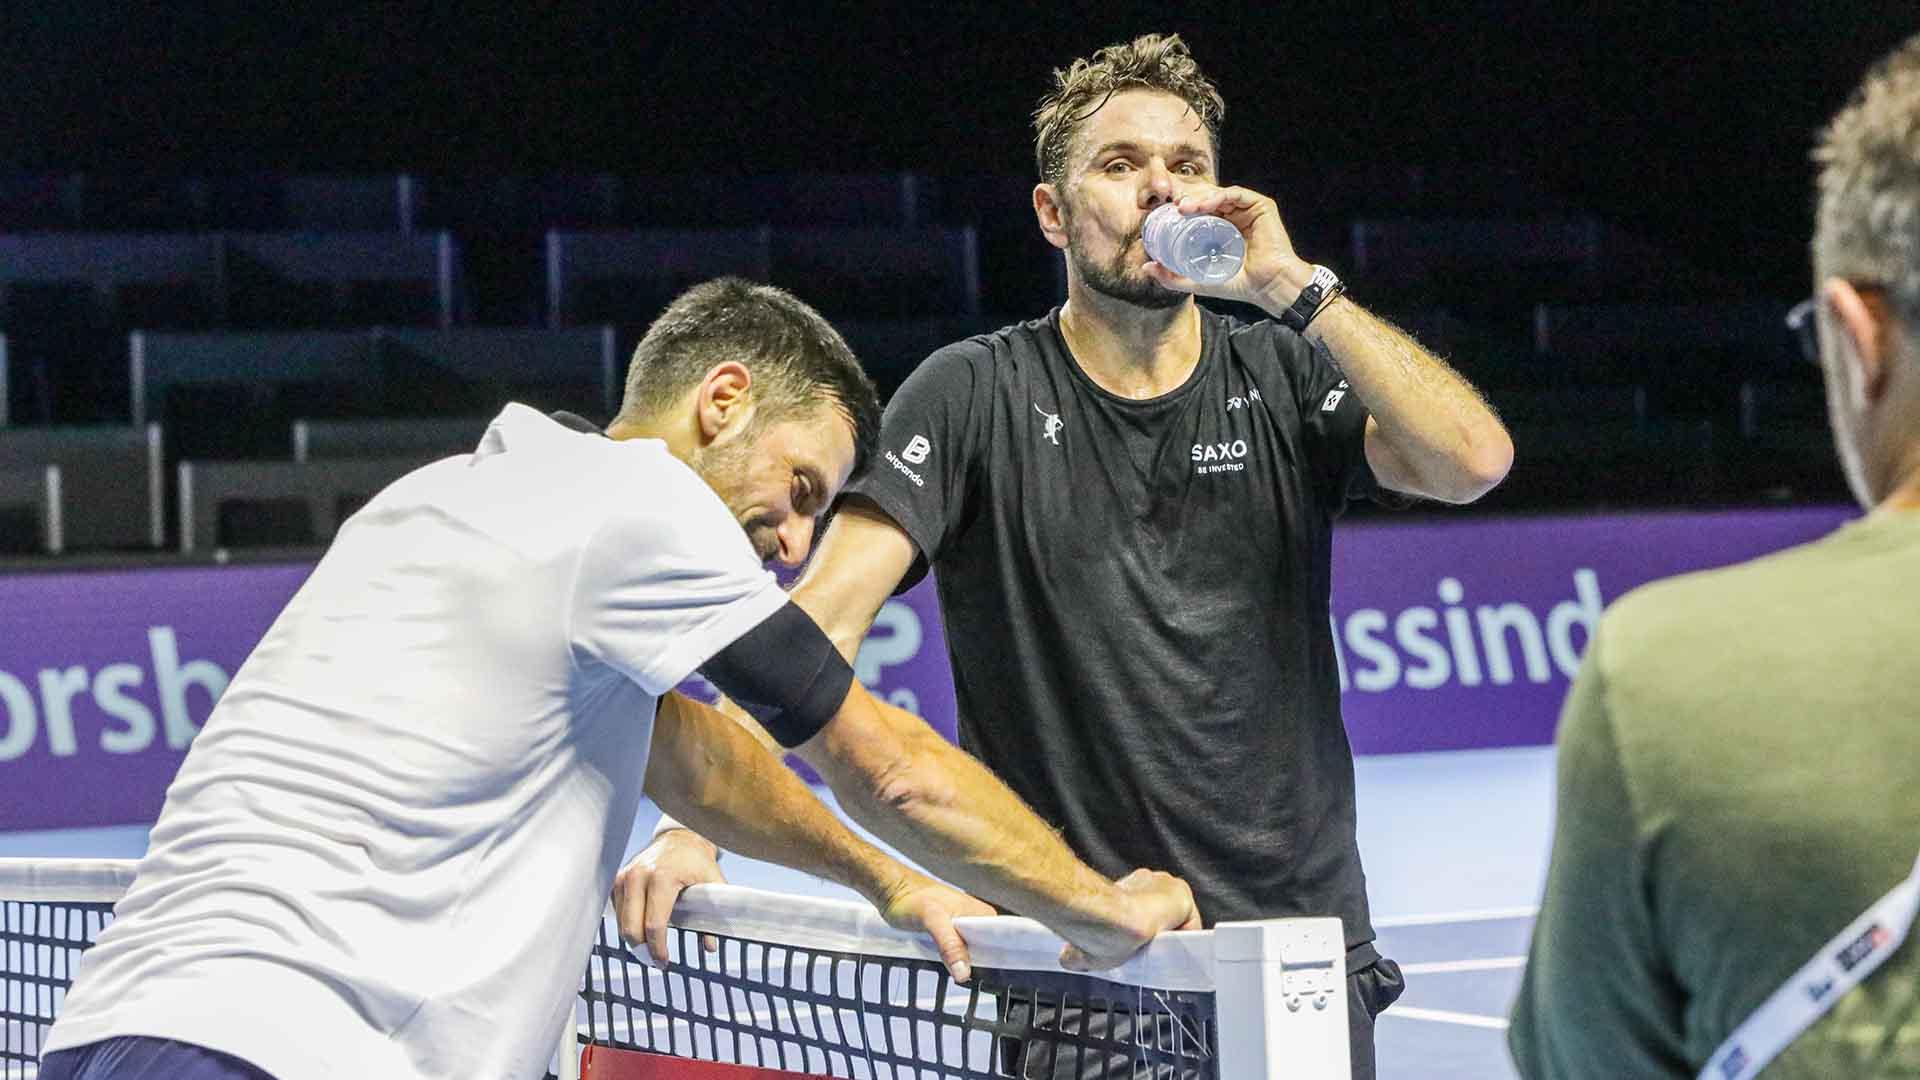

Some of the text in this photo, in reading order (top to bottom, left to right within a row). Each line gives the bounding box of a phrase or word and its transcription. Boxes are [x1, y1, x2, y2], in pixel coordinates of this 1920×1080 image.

[1191, 439, 1248, 462] SAXO
[1197, 462, 1244, 474] BE INVESTED
[1330, 567, 1605, 693] ssind
